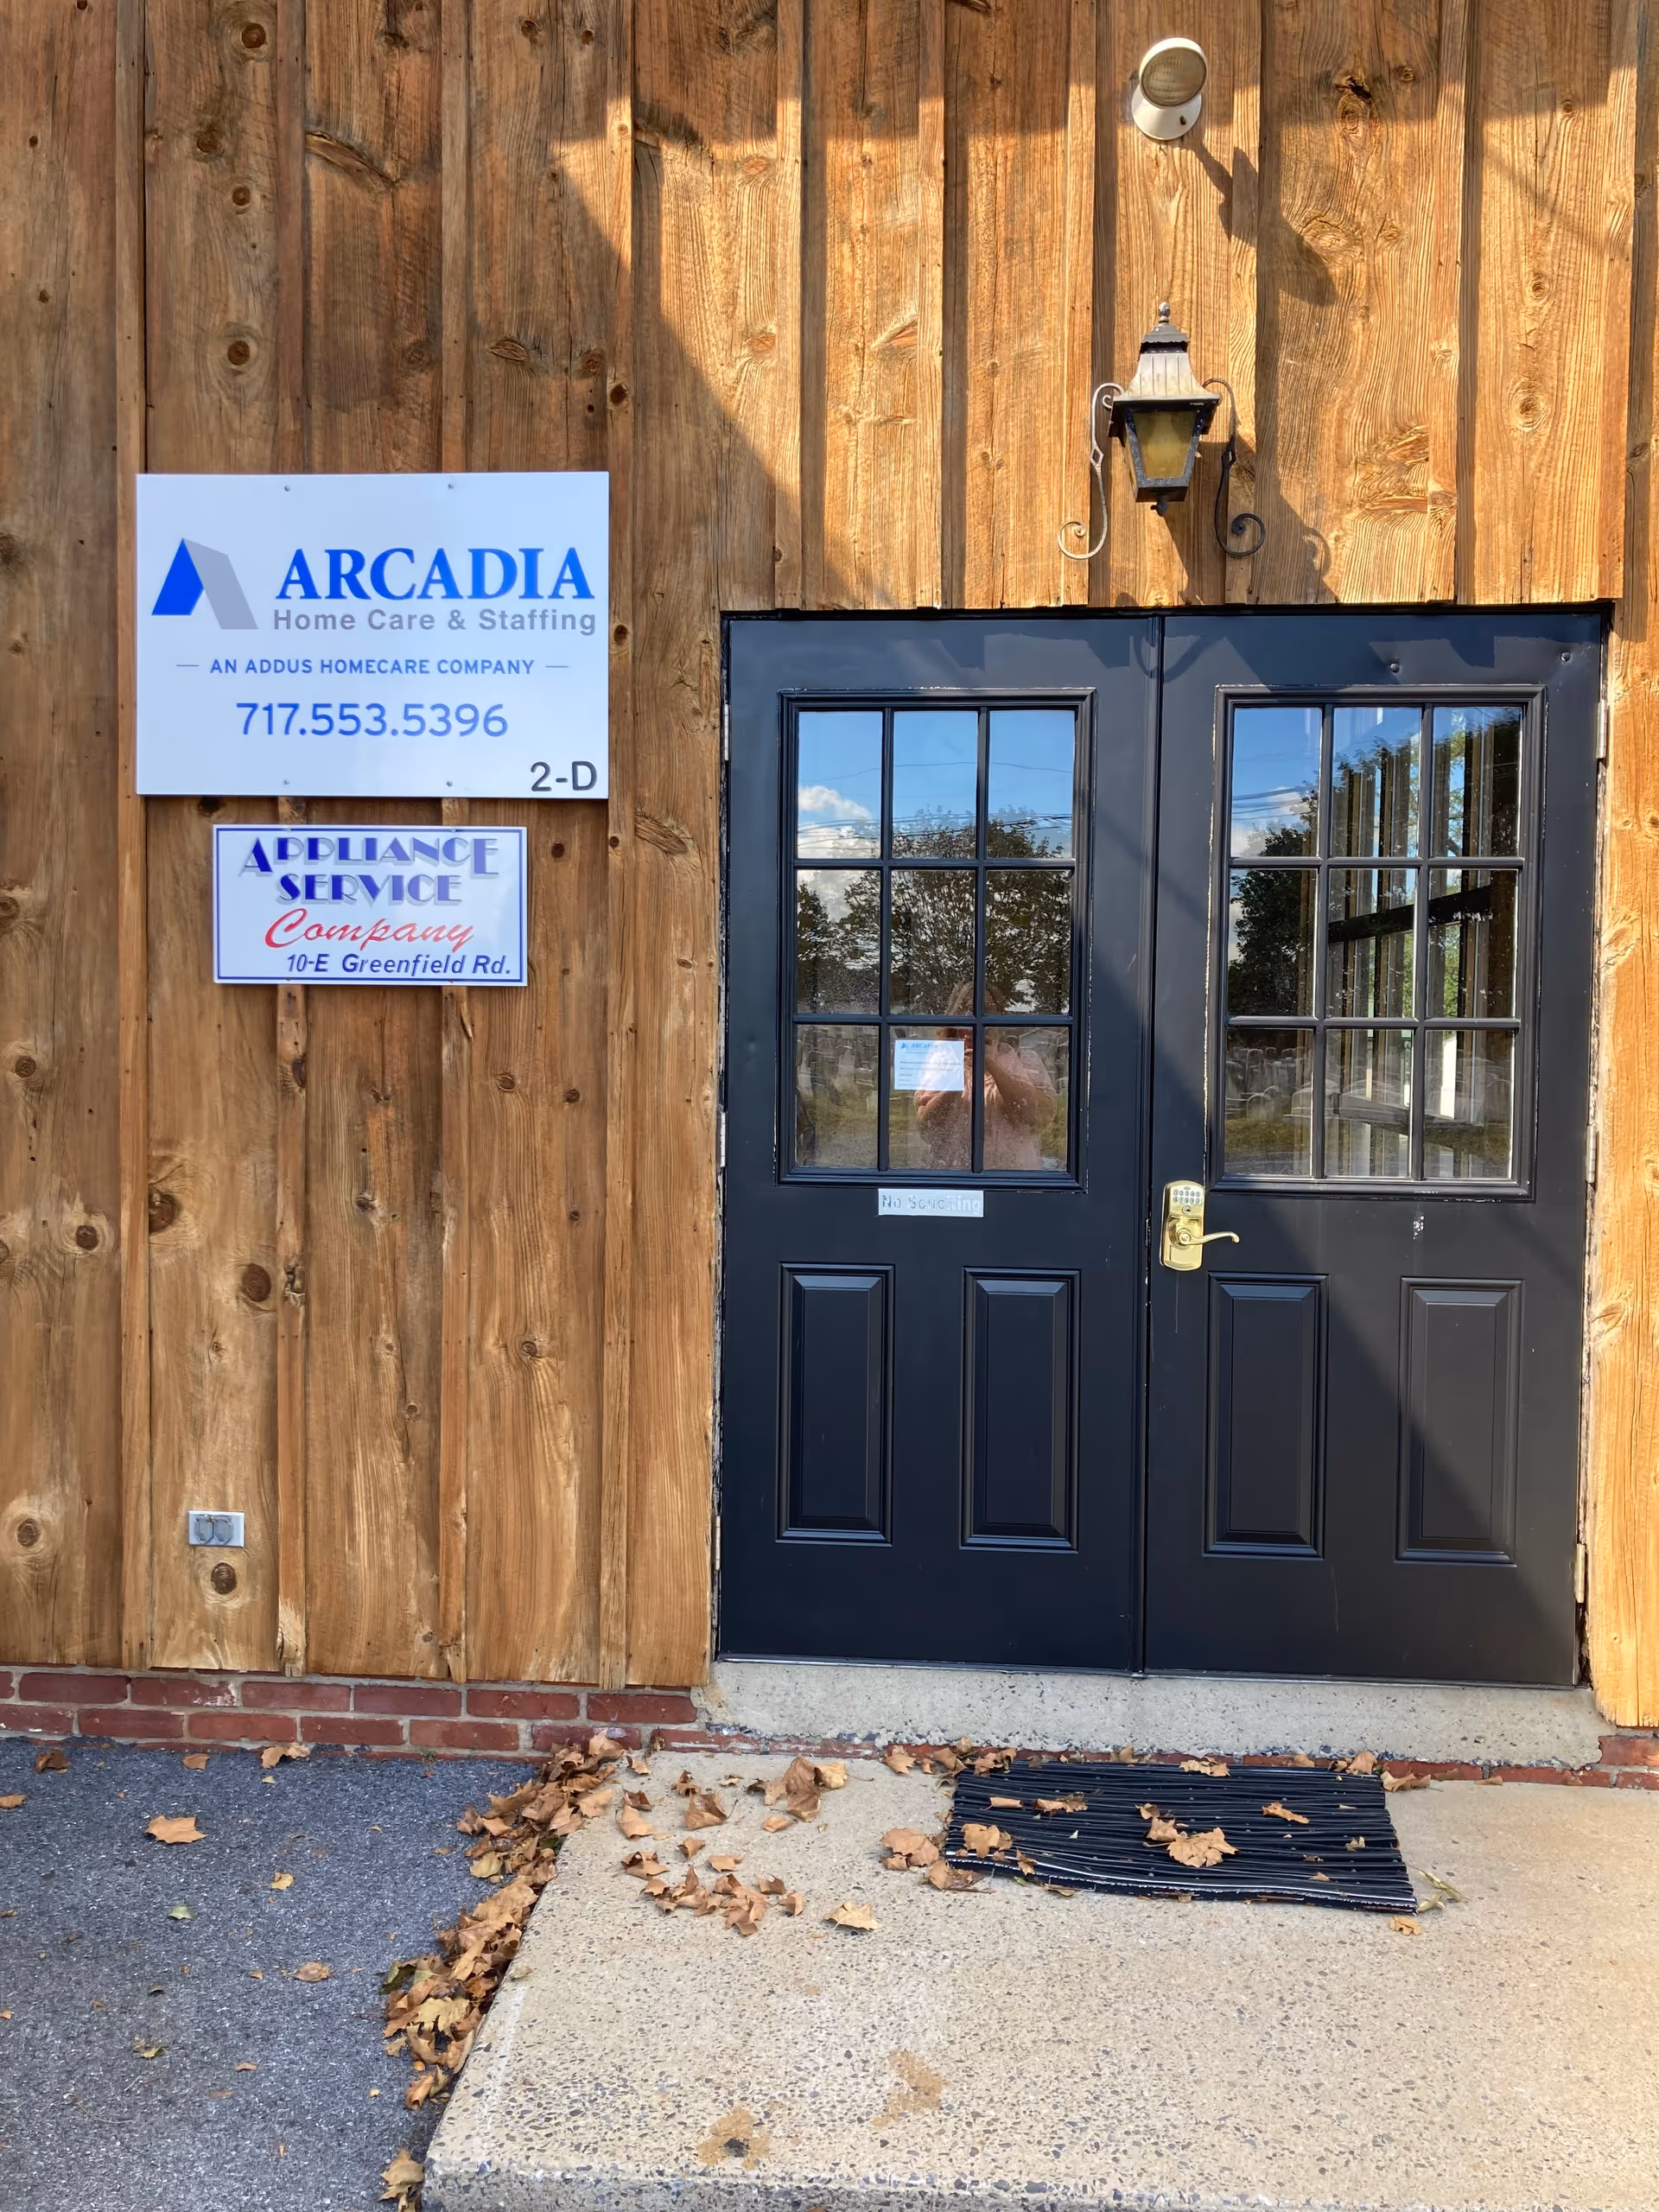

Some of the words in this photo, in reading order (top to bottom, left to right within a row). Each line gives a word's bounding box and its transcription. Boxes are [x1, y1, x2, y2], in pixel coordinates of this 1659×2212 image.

[276, 547, 595, 600] ARCADIA
[273, 609, 356, 631] Home
[367, 609, 436, 631] Care
[448, 610, 467, 631] &
[479, 608, 597, 637] Staffing
[210, 658, 238, 674] AN
[245, 658, 313, 675] ADDUS
[321, 658, 430, 675] HOMECARE
[436, 658, 535, 675] COMPANY
[236, 702, 509, 738] 717.553.5396
[530, 760, 598, 792] 2-D
[239, 836, 500, 878] APPLIANCE
[276, 873, 462, 906] SERVICE
[264, 907, 475, 953] Company
[287, 953, 330, 973] 10-E
[342, 953, 467, 977] Greenfield
[473, 955, 512, 975] Rd.
[882, 1194, 902, 1209] No
